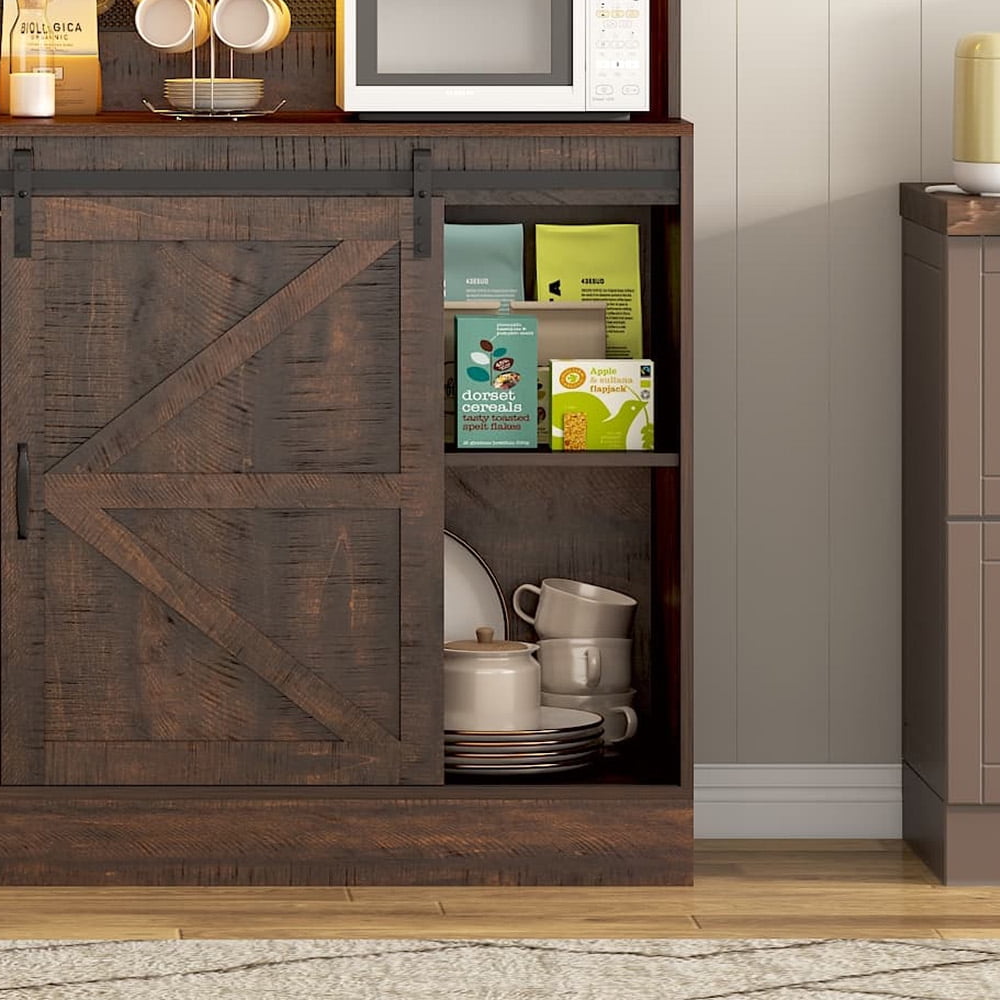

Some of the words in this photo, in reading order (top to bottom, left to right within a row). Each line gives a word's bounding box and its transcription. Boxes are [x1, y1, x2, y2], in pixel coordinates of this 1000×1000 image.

[590, 368, 617, 376] Apple
[590, 385, 626, 393] flapjack
[462, 390, 516, 401] dorset
[462, 402, 522, 412] cereals
[463, 415, 489, 423] tasty
[492, 414, 530, 422] toasted
[463, 423, 488, 431] spelt
